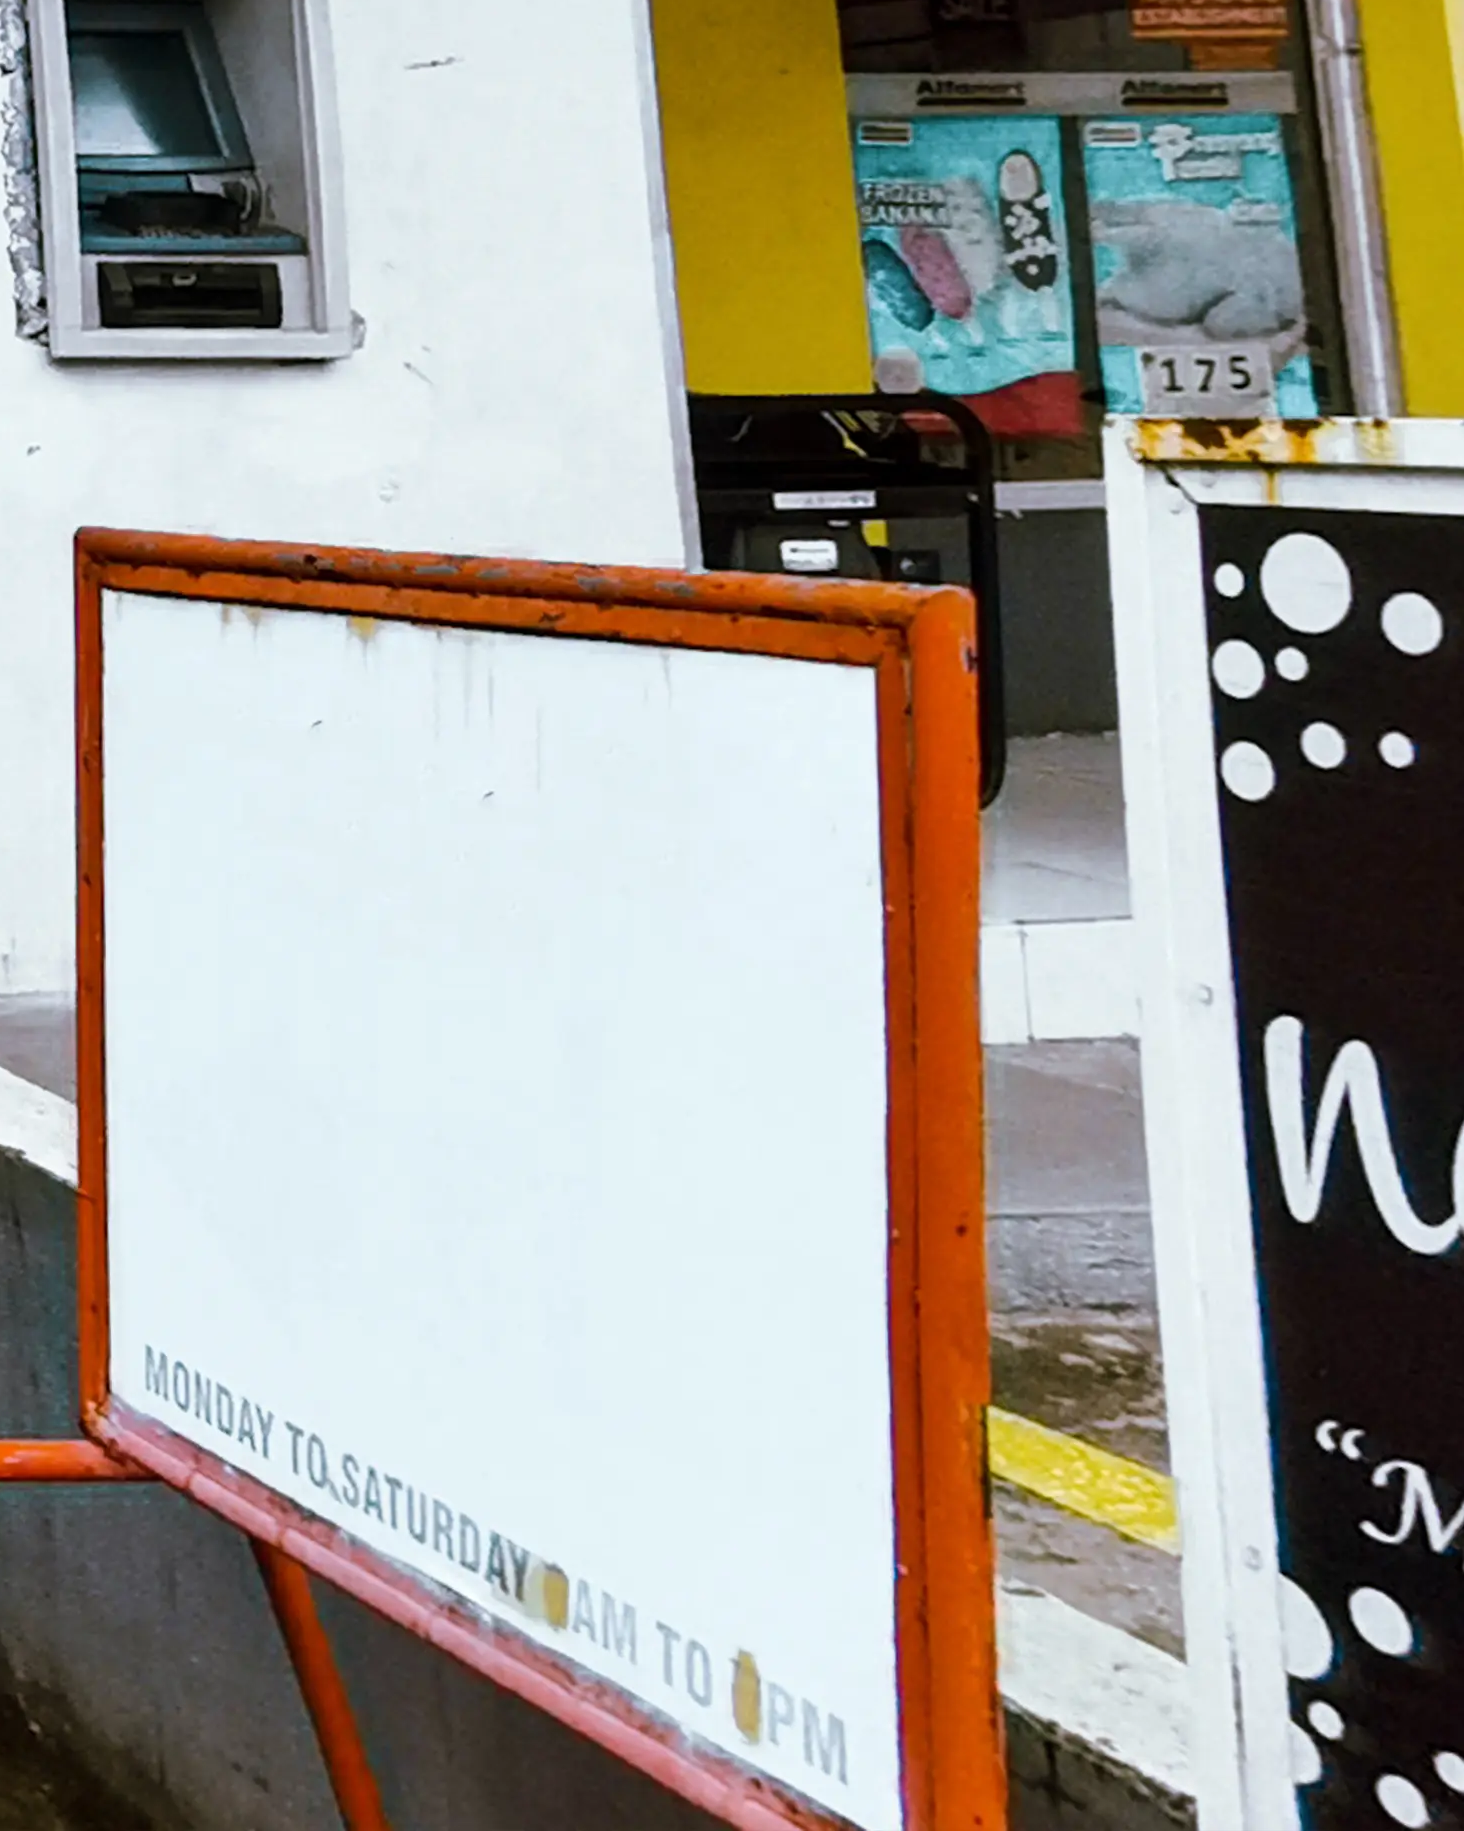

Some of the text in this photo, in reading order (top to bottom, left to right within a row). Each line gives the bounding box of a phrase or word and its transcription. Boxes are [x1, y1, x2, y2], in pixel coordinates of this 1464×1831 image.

[144, 1344, 275, 1460] MONDAY
[284, 1420, 330, 1490] TO
[340, 1453, 532, 1603] SATURDAY
[655, 1619, 714, 1708] TO
